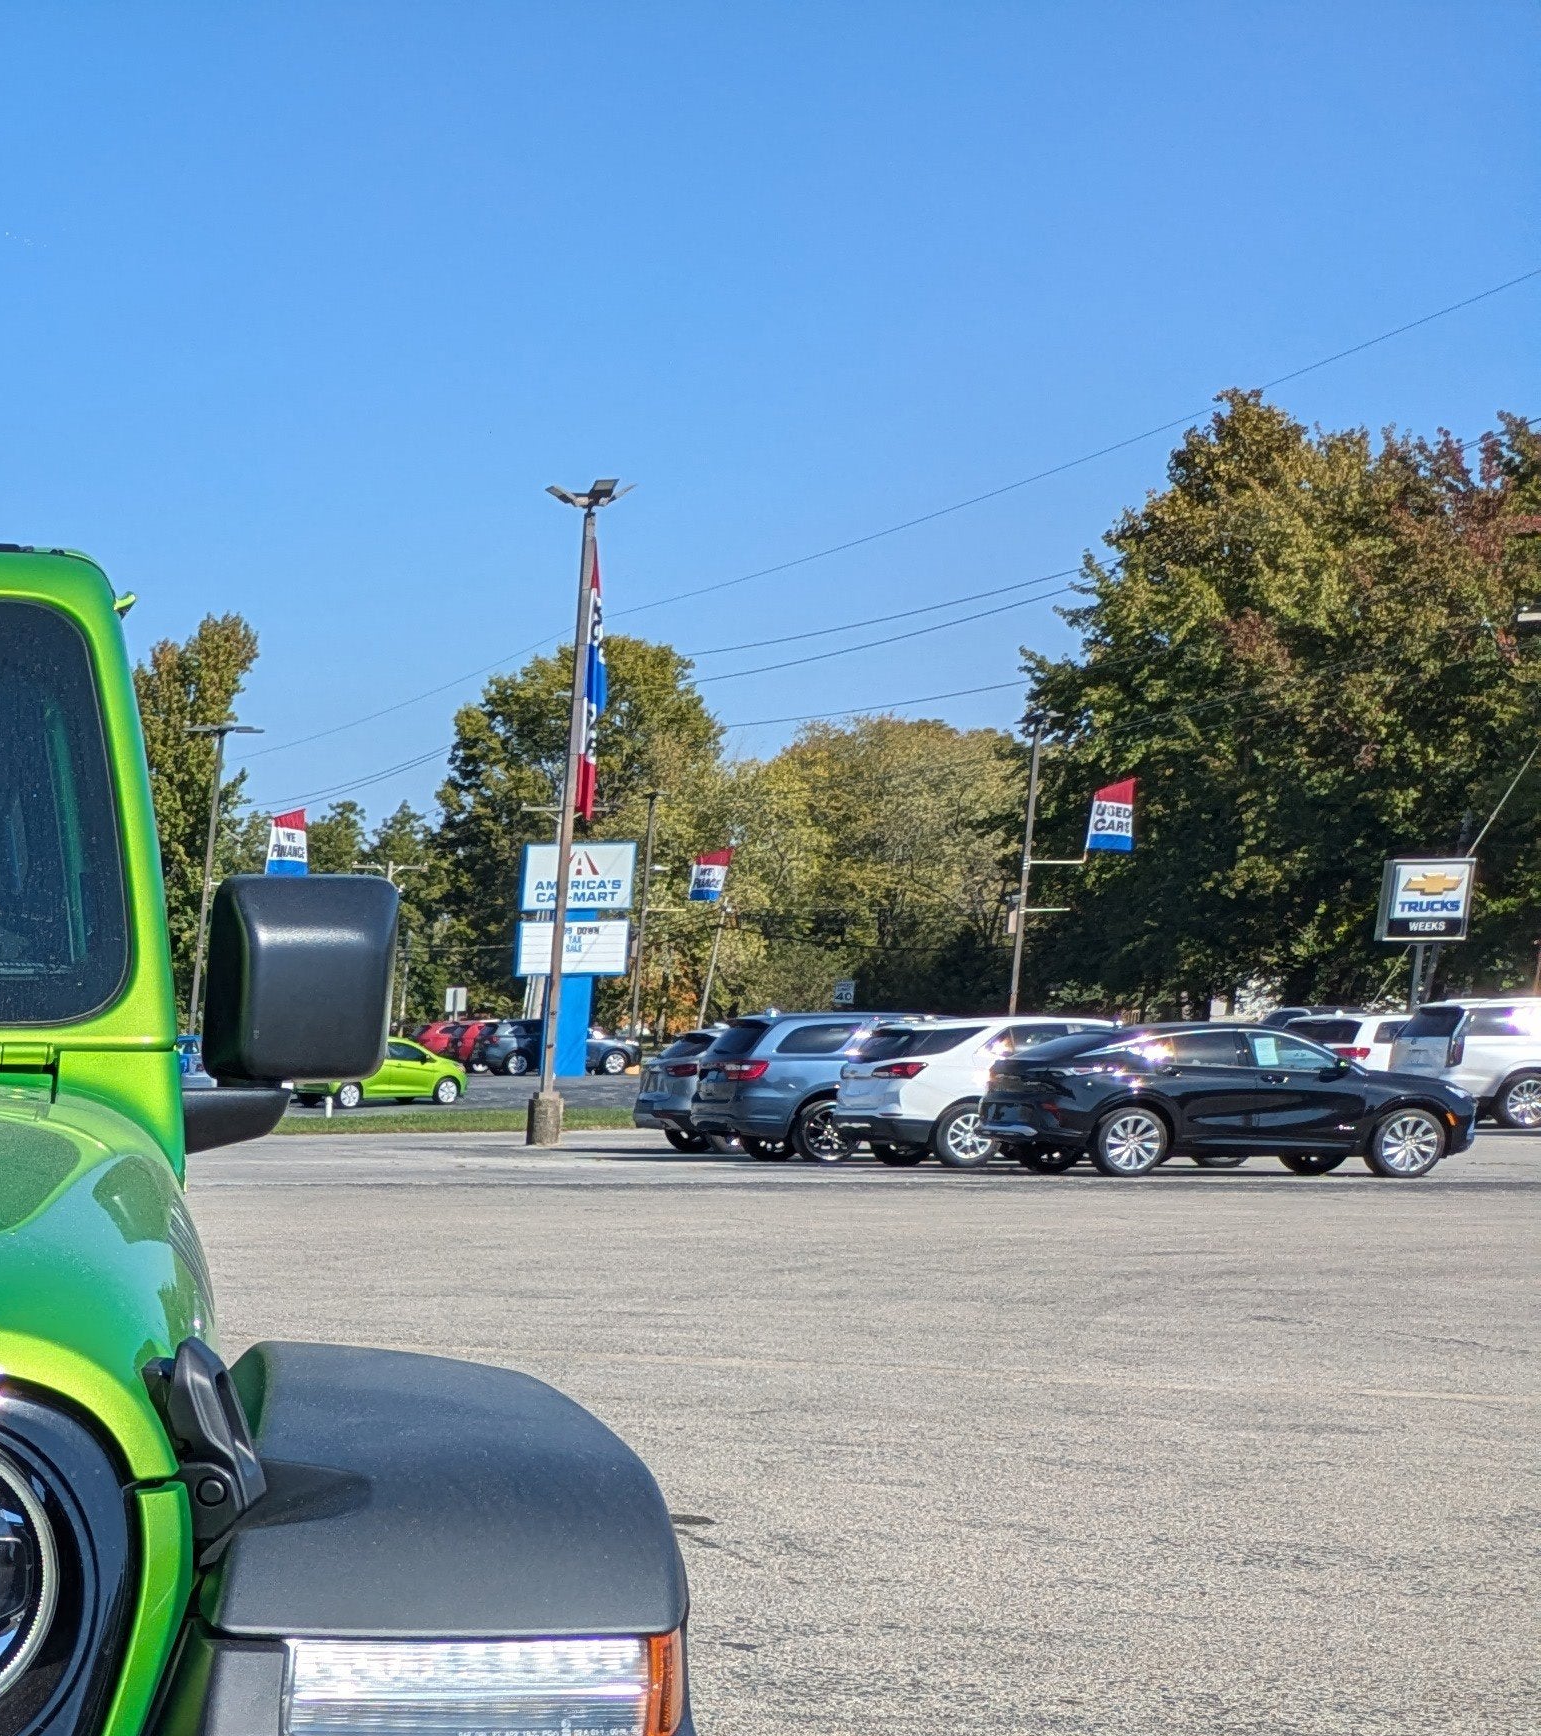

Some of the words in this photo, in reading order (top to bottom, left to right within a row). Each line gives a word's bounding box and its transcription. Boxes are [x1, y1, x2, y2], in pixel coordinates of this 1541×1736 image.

[1096, 804, 1131, 819] USED
[1094, 818, 1130, 833] CARS
[535, 880, 622, 890] AMRICA'S
[536, 892, 618, 902] CA-MART
[1398, 900, 1461, 912] TRUCKS
[577, 926, 600, 934] DOWN
[1408, 921, 1446, 931] WEEKS
[835, 992, 852, 1001] 40
